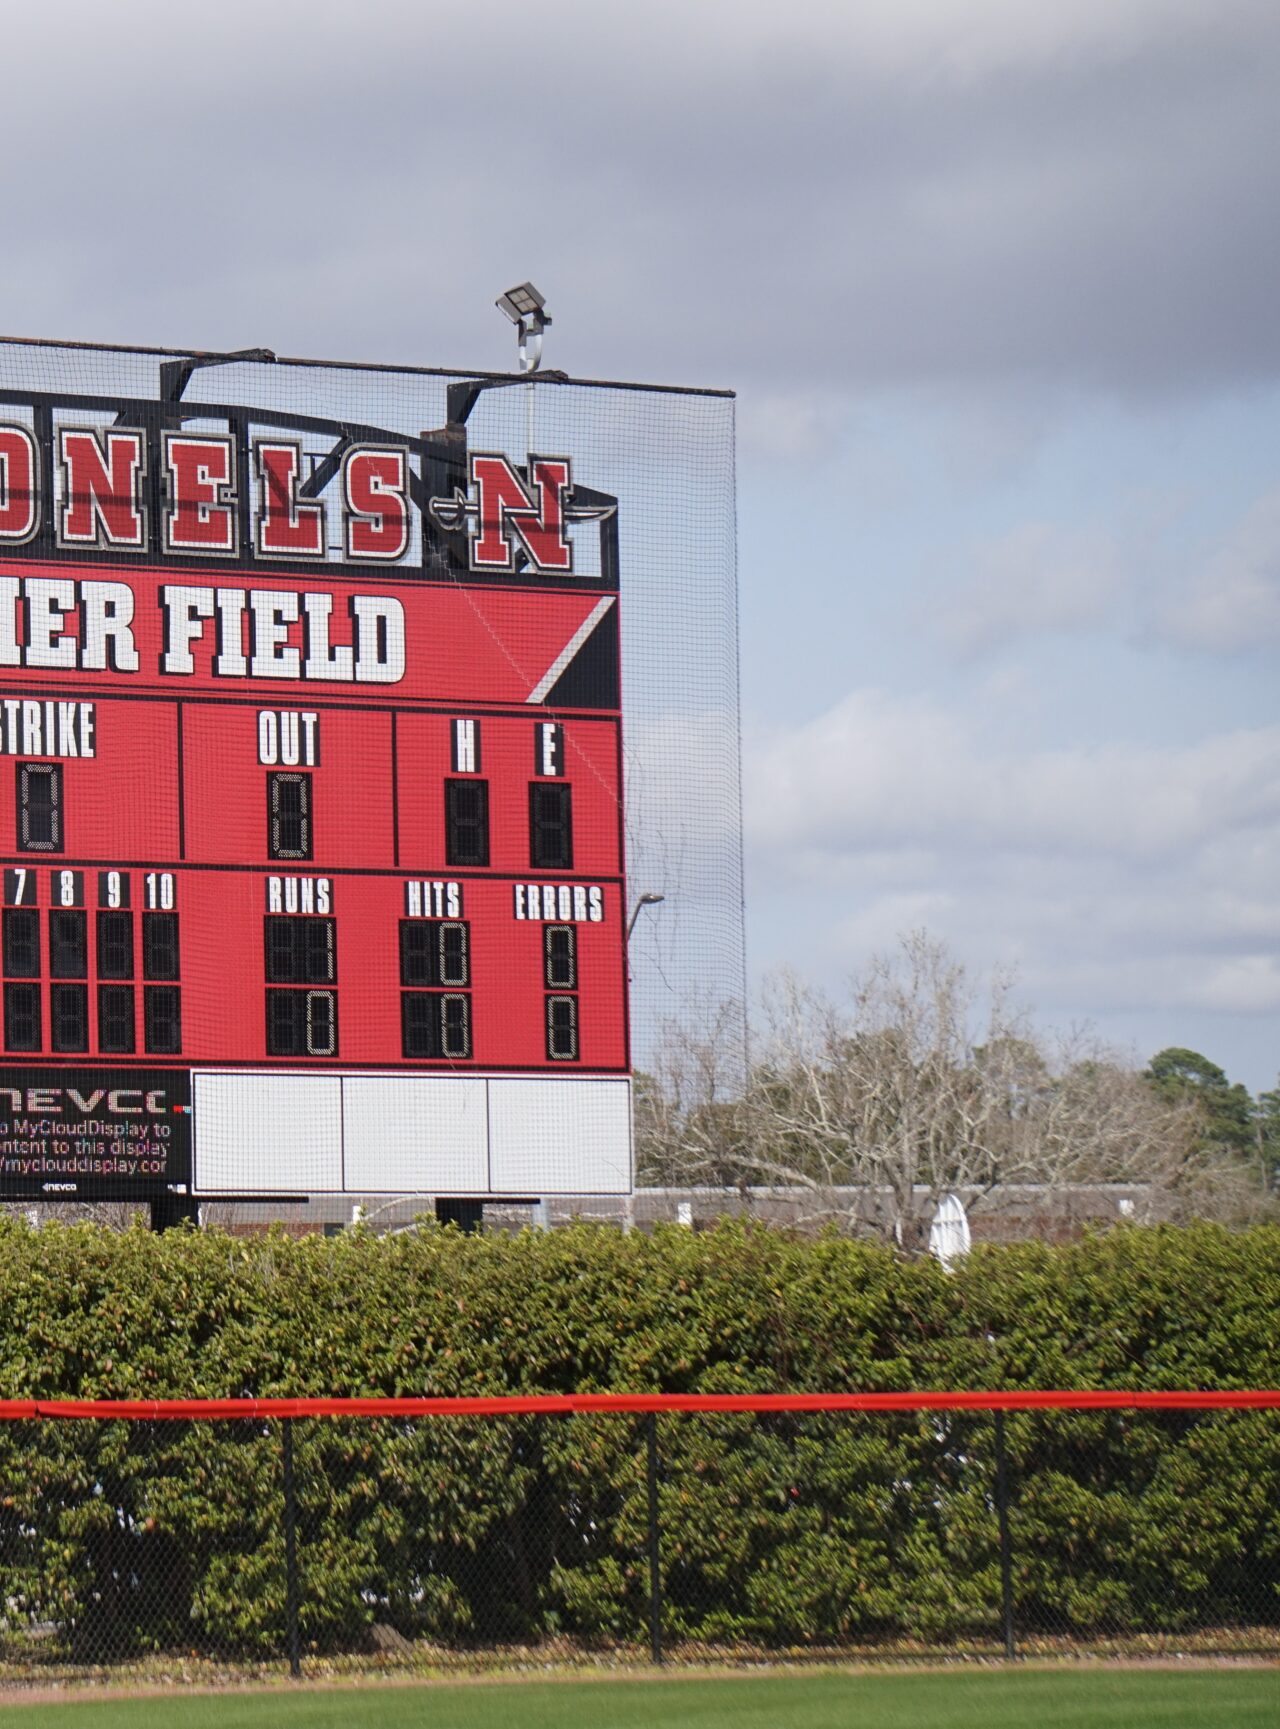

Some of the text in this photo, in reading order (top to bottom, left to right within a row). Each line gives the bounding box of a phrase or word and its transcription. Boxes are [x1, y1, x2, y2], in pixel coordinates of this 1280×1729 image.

[468, 451, 575, 574] N
[160, 584, 407, 685] FIELD
[258, 710, 318, 766] OUT
[456, 719, 476, 773] H
[542, 722, 557, 776] E
[21, 764, 58, 850] 0
[273, 773, 308, 858] 0
[14, 868, 27, 906] 7
[60, 870, 74, 907] 8
[107, 871, 121, 909] 9
[146, 873, 174, 910] 10
[268, 876, 330, 915] RUNS
[408, 881, 460, 918] HITS
[515, 884, 604, 922] ERRORS
[326, 921, 334, 981] 1
[439, 922, 468, 986] 0
[546, 925, 575, 989] 0
[306, 990, 335, 1055] 0
[440, 993, 469, 1058] 0
[547, 995, 576, 1060] 0
[13, 1119, 149, 1140] MyCloudDisplay
[153, 1122, 171, 1138] to
[52, 1139, 70, 1155] to
[75, 1138, 105, 1156] this
[110, 1138, 170, 1158] display
